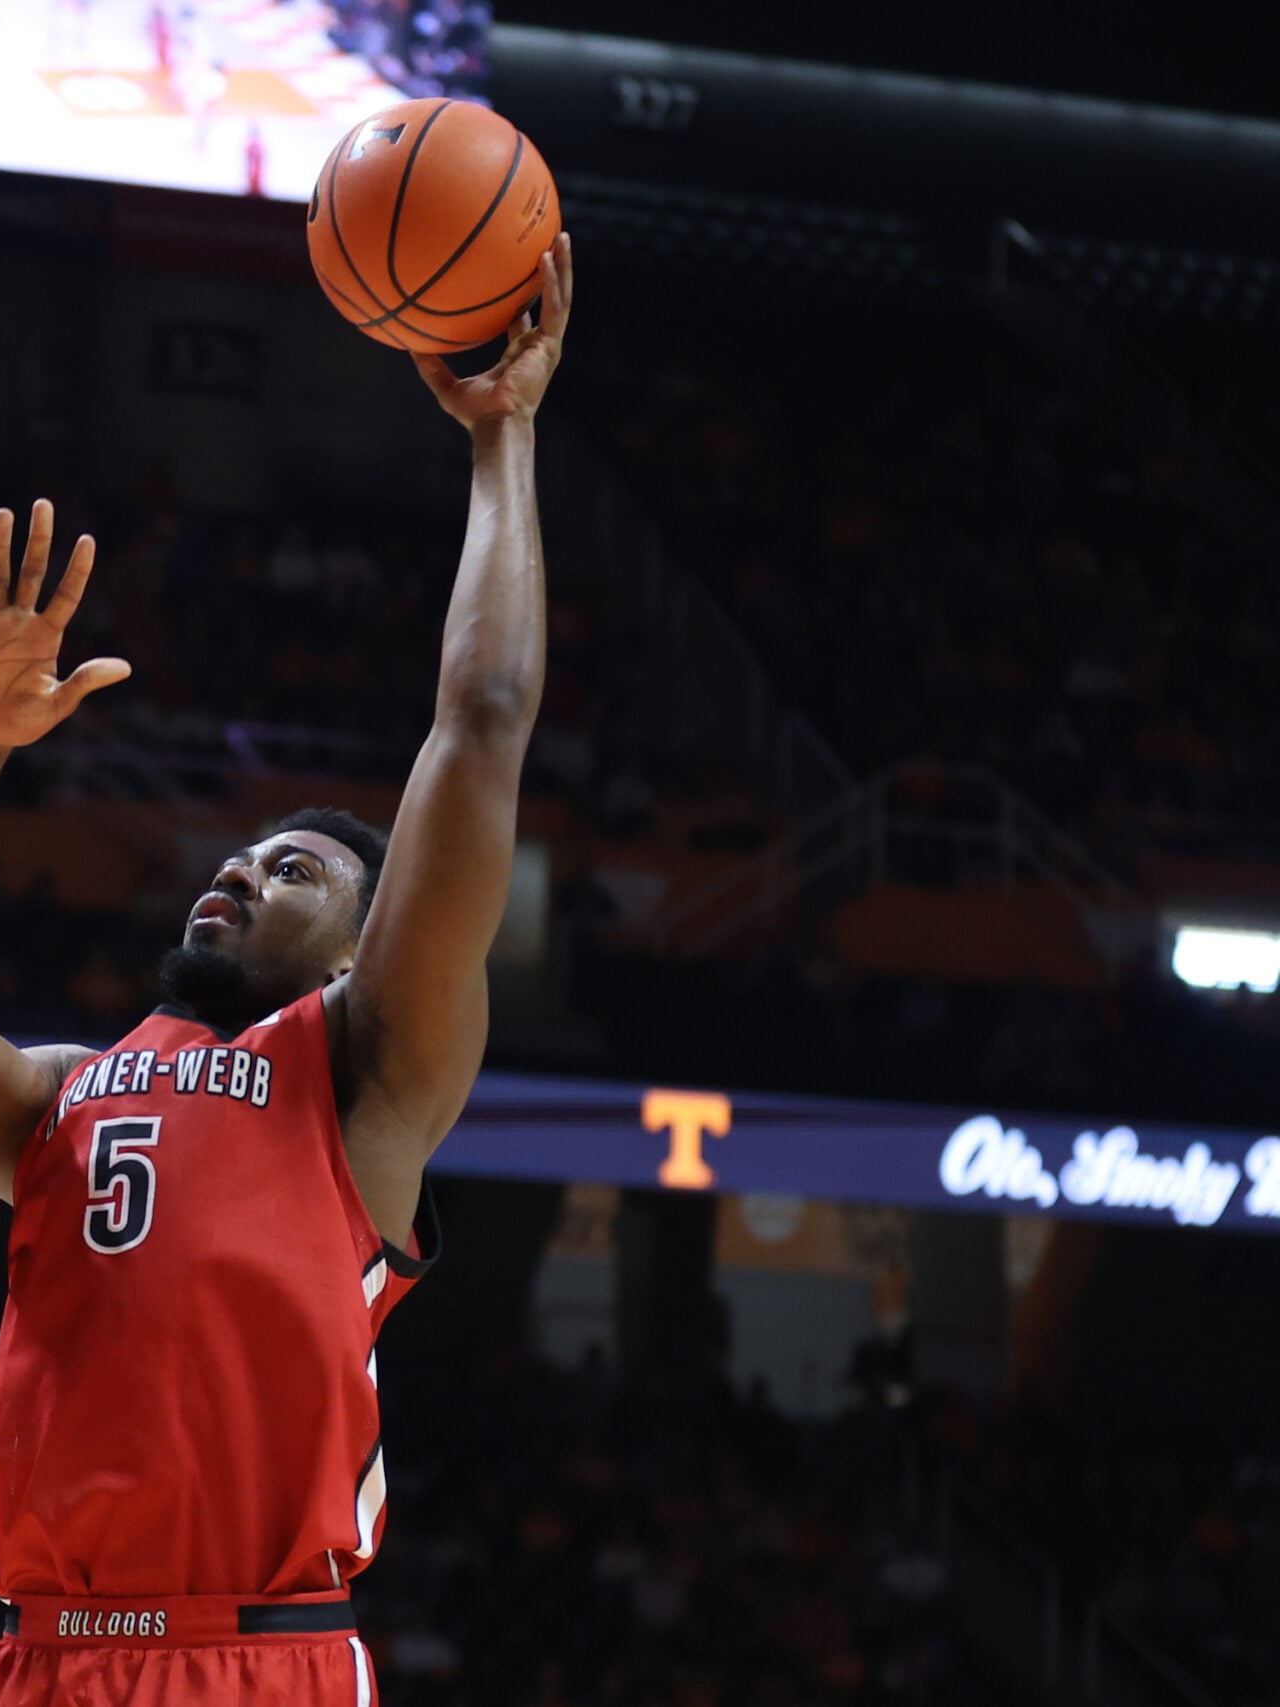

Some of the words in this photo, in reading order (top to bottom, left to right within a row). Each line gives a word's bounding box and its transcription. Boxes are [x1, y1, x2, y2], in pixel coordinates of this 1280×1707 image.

[82, 1115, 163, 1255] 5
[641, 1088, 732, 1190] T
[57, 1610, 168, 1638] BULLDOGS
